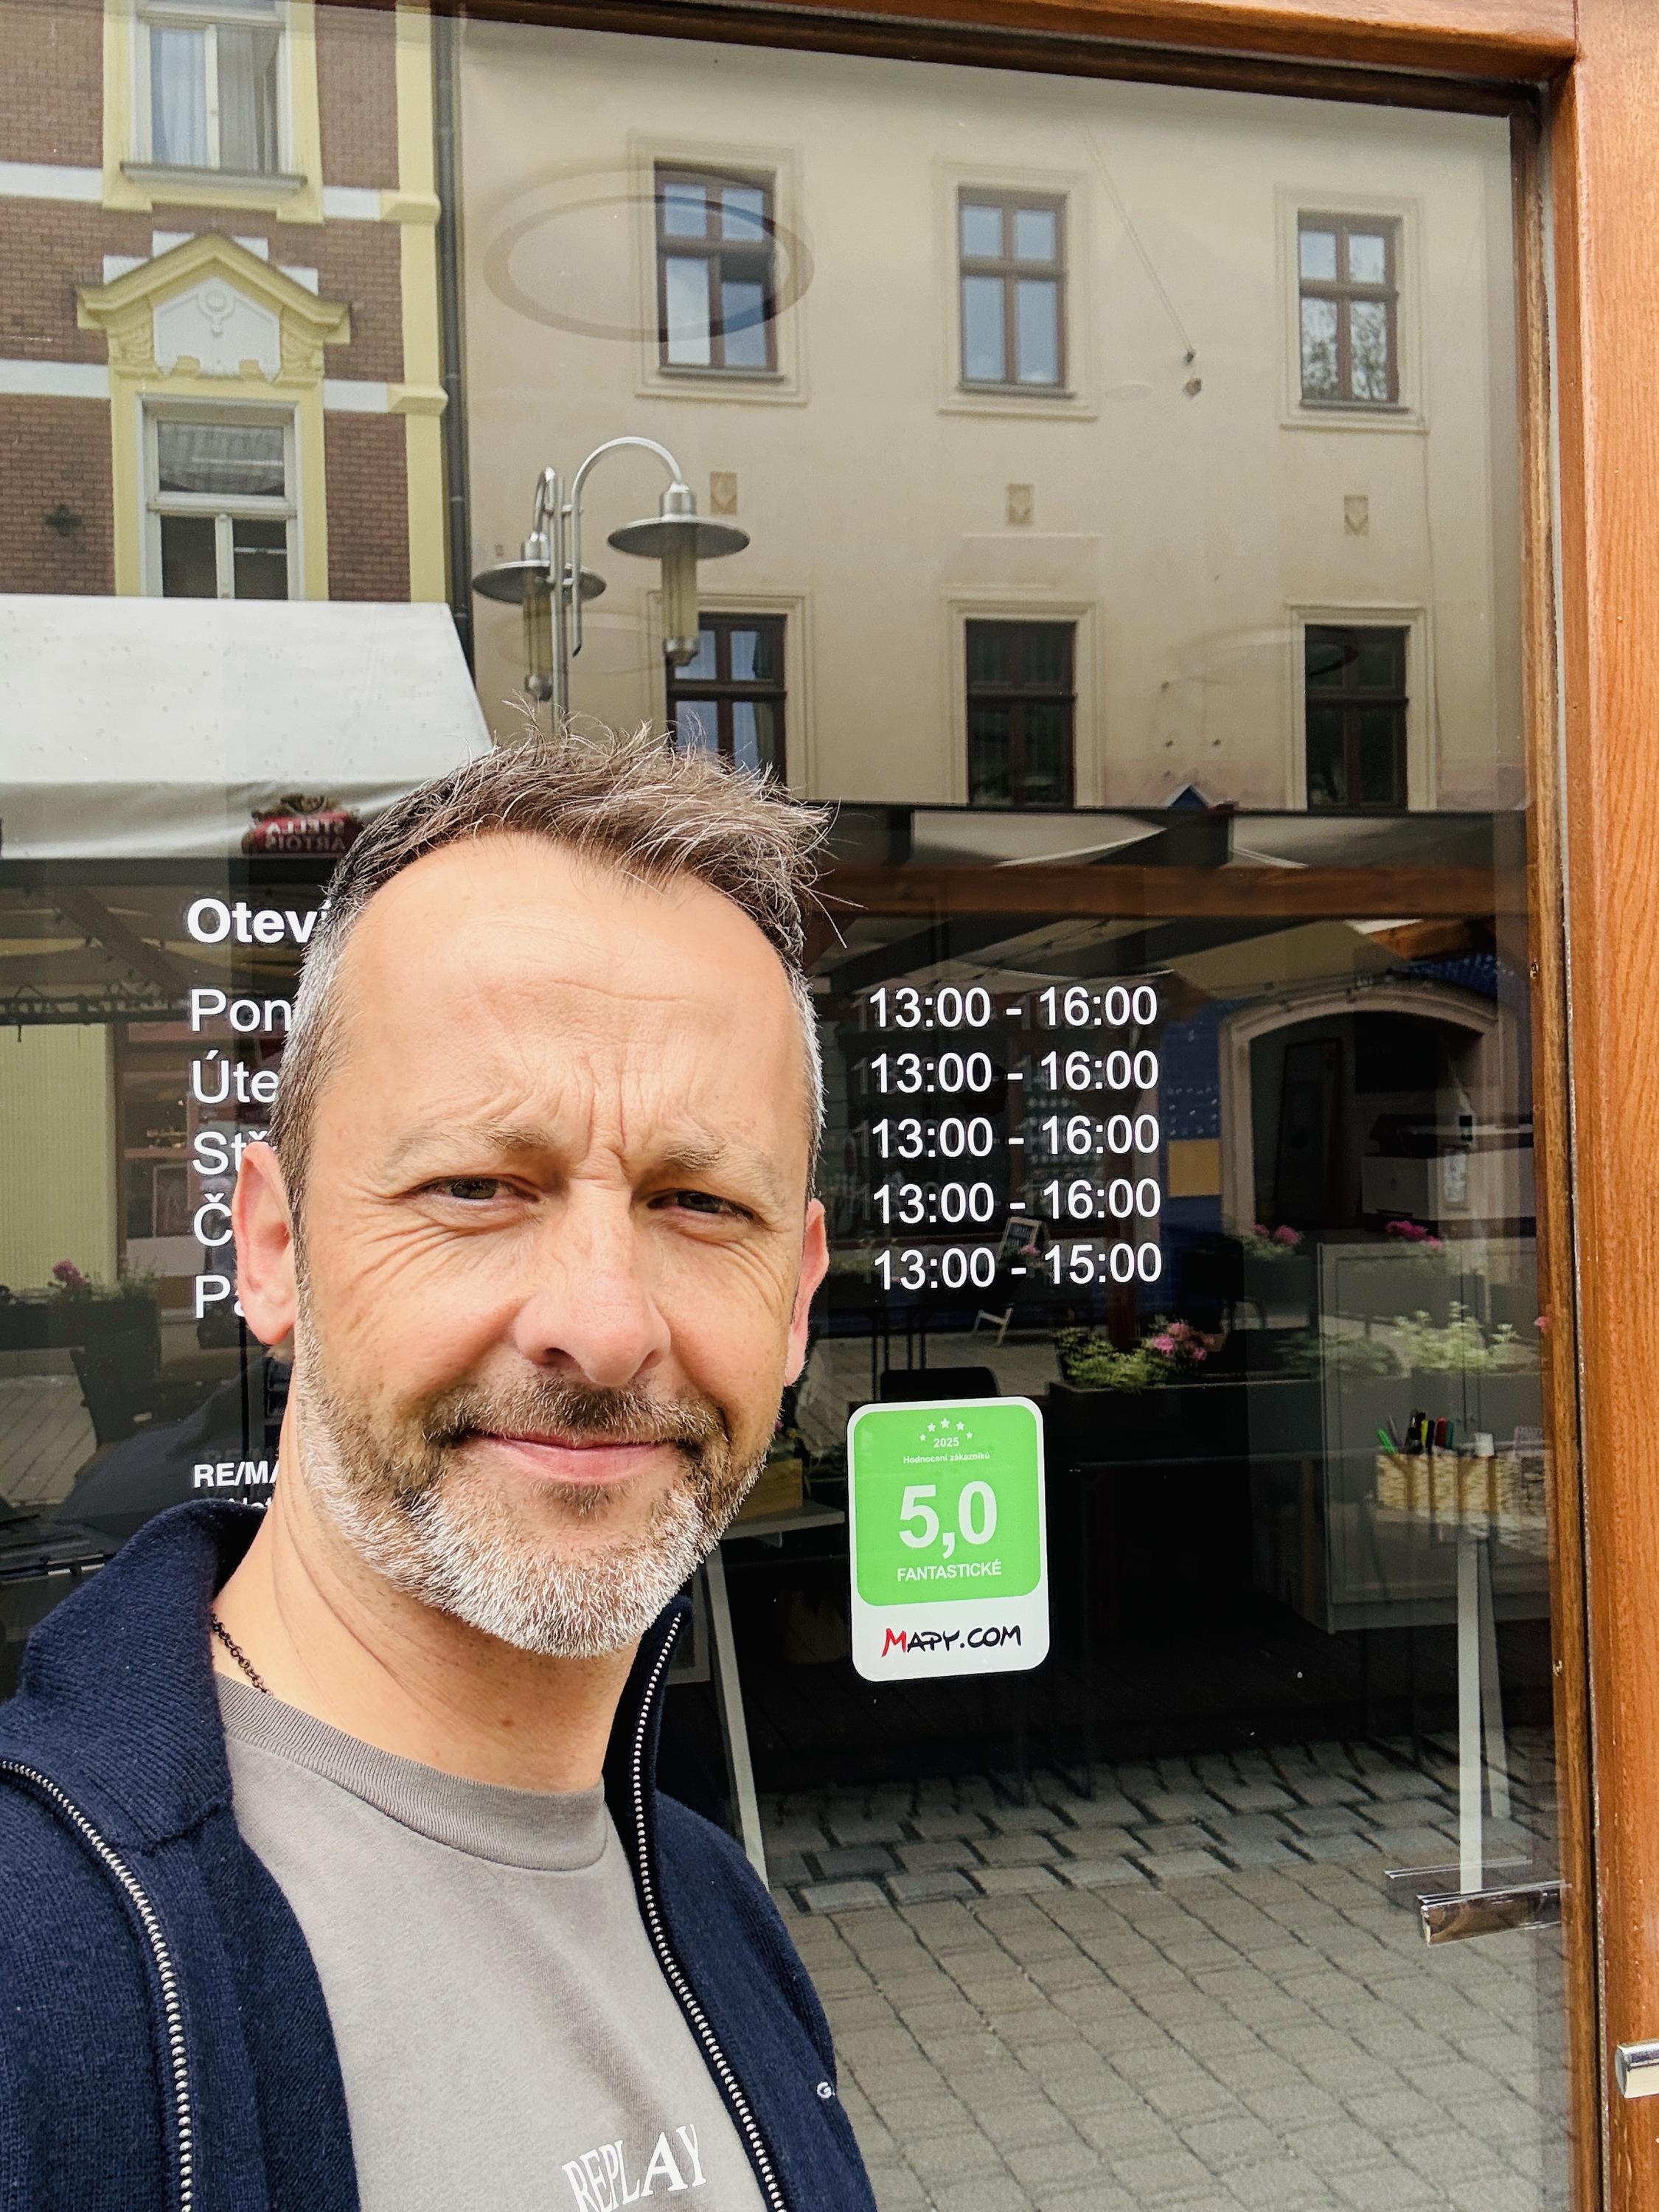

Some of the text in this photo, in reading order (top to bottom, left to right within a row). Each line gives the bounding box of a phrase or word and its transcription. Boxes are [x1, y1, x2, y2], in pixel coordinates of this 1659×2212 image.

[870, 987, 991, 1028] 13:00
[1040, 986, 1158, 1026] 16:00
[871, 1052, 992, 1093] 13:00
[1041, 1049, 1158, 1091] 16:00
[872, 1117, 993, 1158] 13:00
[1042, 1114, 1160, 1155] 16:00
[873, 1178, 1161, 1224] 13:00 - 16:00
[874, 1247, 995, 1290] 13:00
[1045, 1242, 1162, 1284] 15:00
[195, 1274, 246, 1318] P
[933, 1436, 959, 1447] 2025
[899, 1481, 997, 1559] 5,0
[897, 1559, 1002, 1582] FANTASTICKÉ
[561, 2124, 708, 2212] REPLAY
